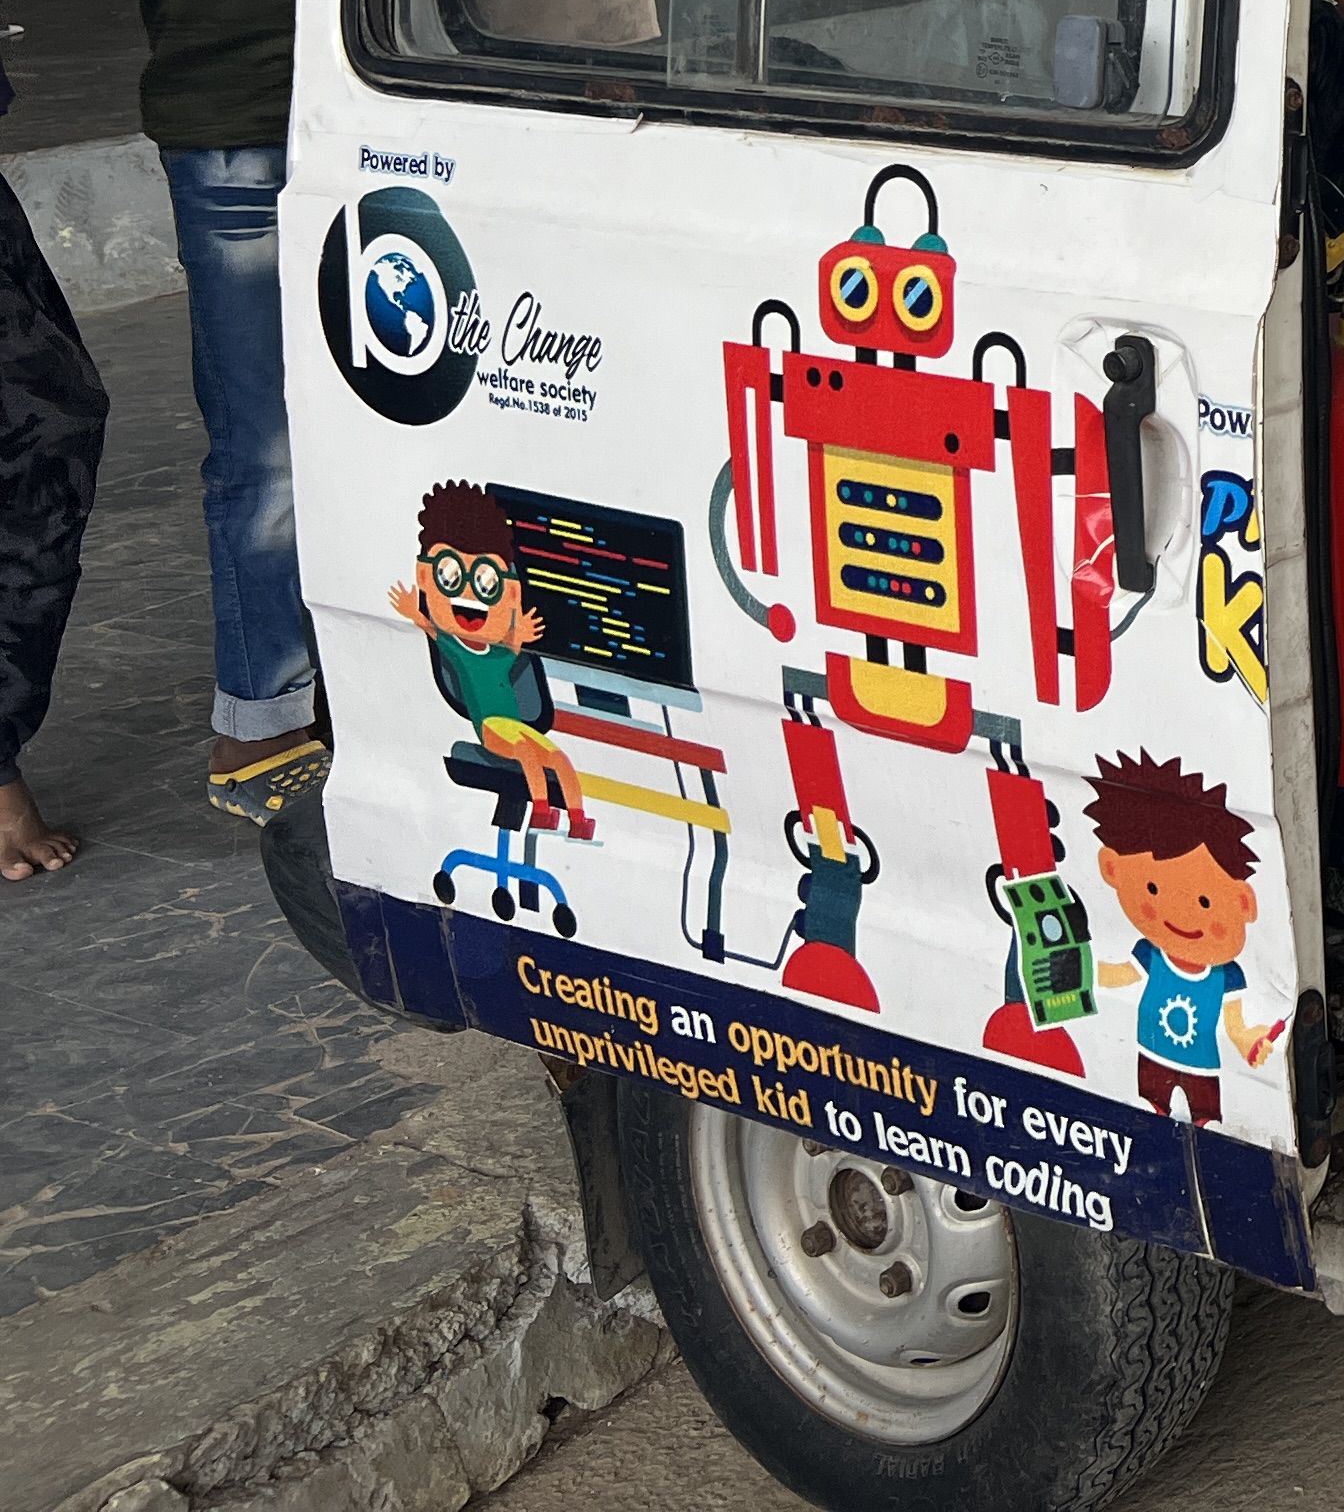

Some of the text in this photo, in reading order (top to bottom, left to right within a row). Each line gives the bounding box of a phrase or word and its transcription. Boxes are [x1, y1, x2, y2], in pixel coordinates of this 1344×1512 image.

[361, 148, 455, 181] Powered by
[451, 291, 491, 352] the
[501, 291, 603, 380] Change
[477, 367, 597, 411] welfare society
[552, 404, 561, 417] of
[564, 405, 588, 422] 2015
[1198, 399, 1254, 435] Pow
[1201, 472, 1261, 551] P
[516, 954, 1133, 1175] Creating an opportunity for every
[529, 1017, 1114, 1232] unprivileged kid to learn coding
[872, 1451, 945, 1480] RADIAL
